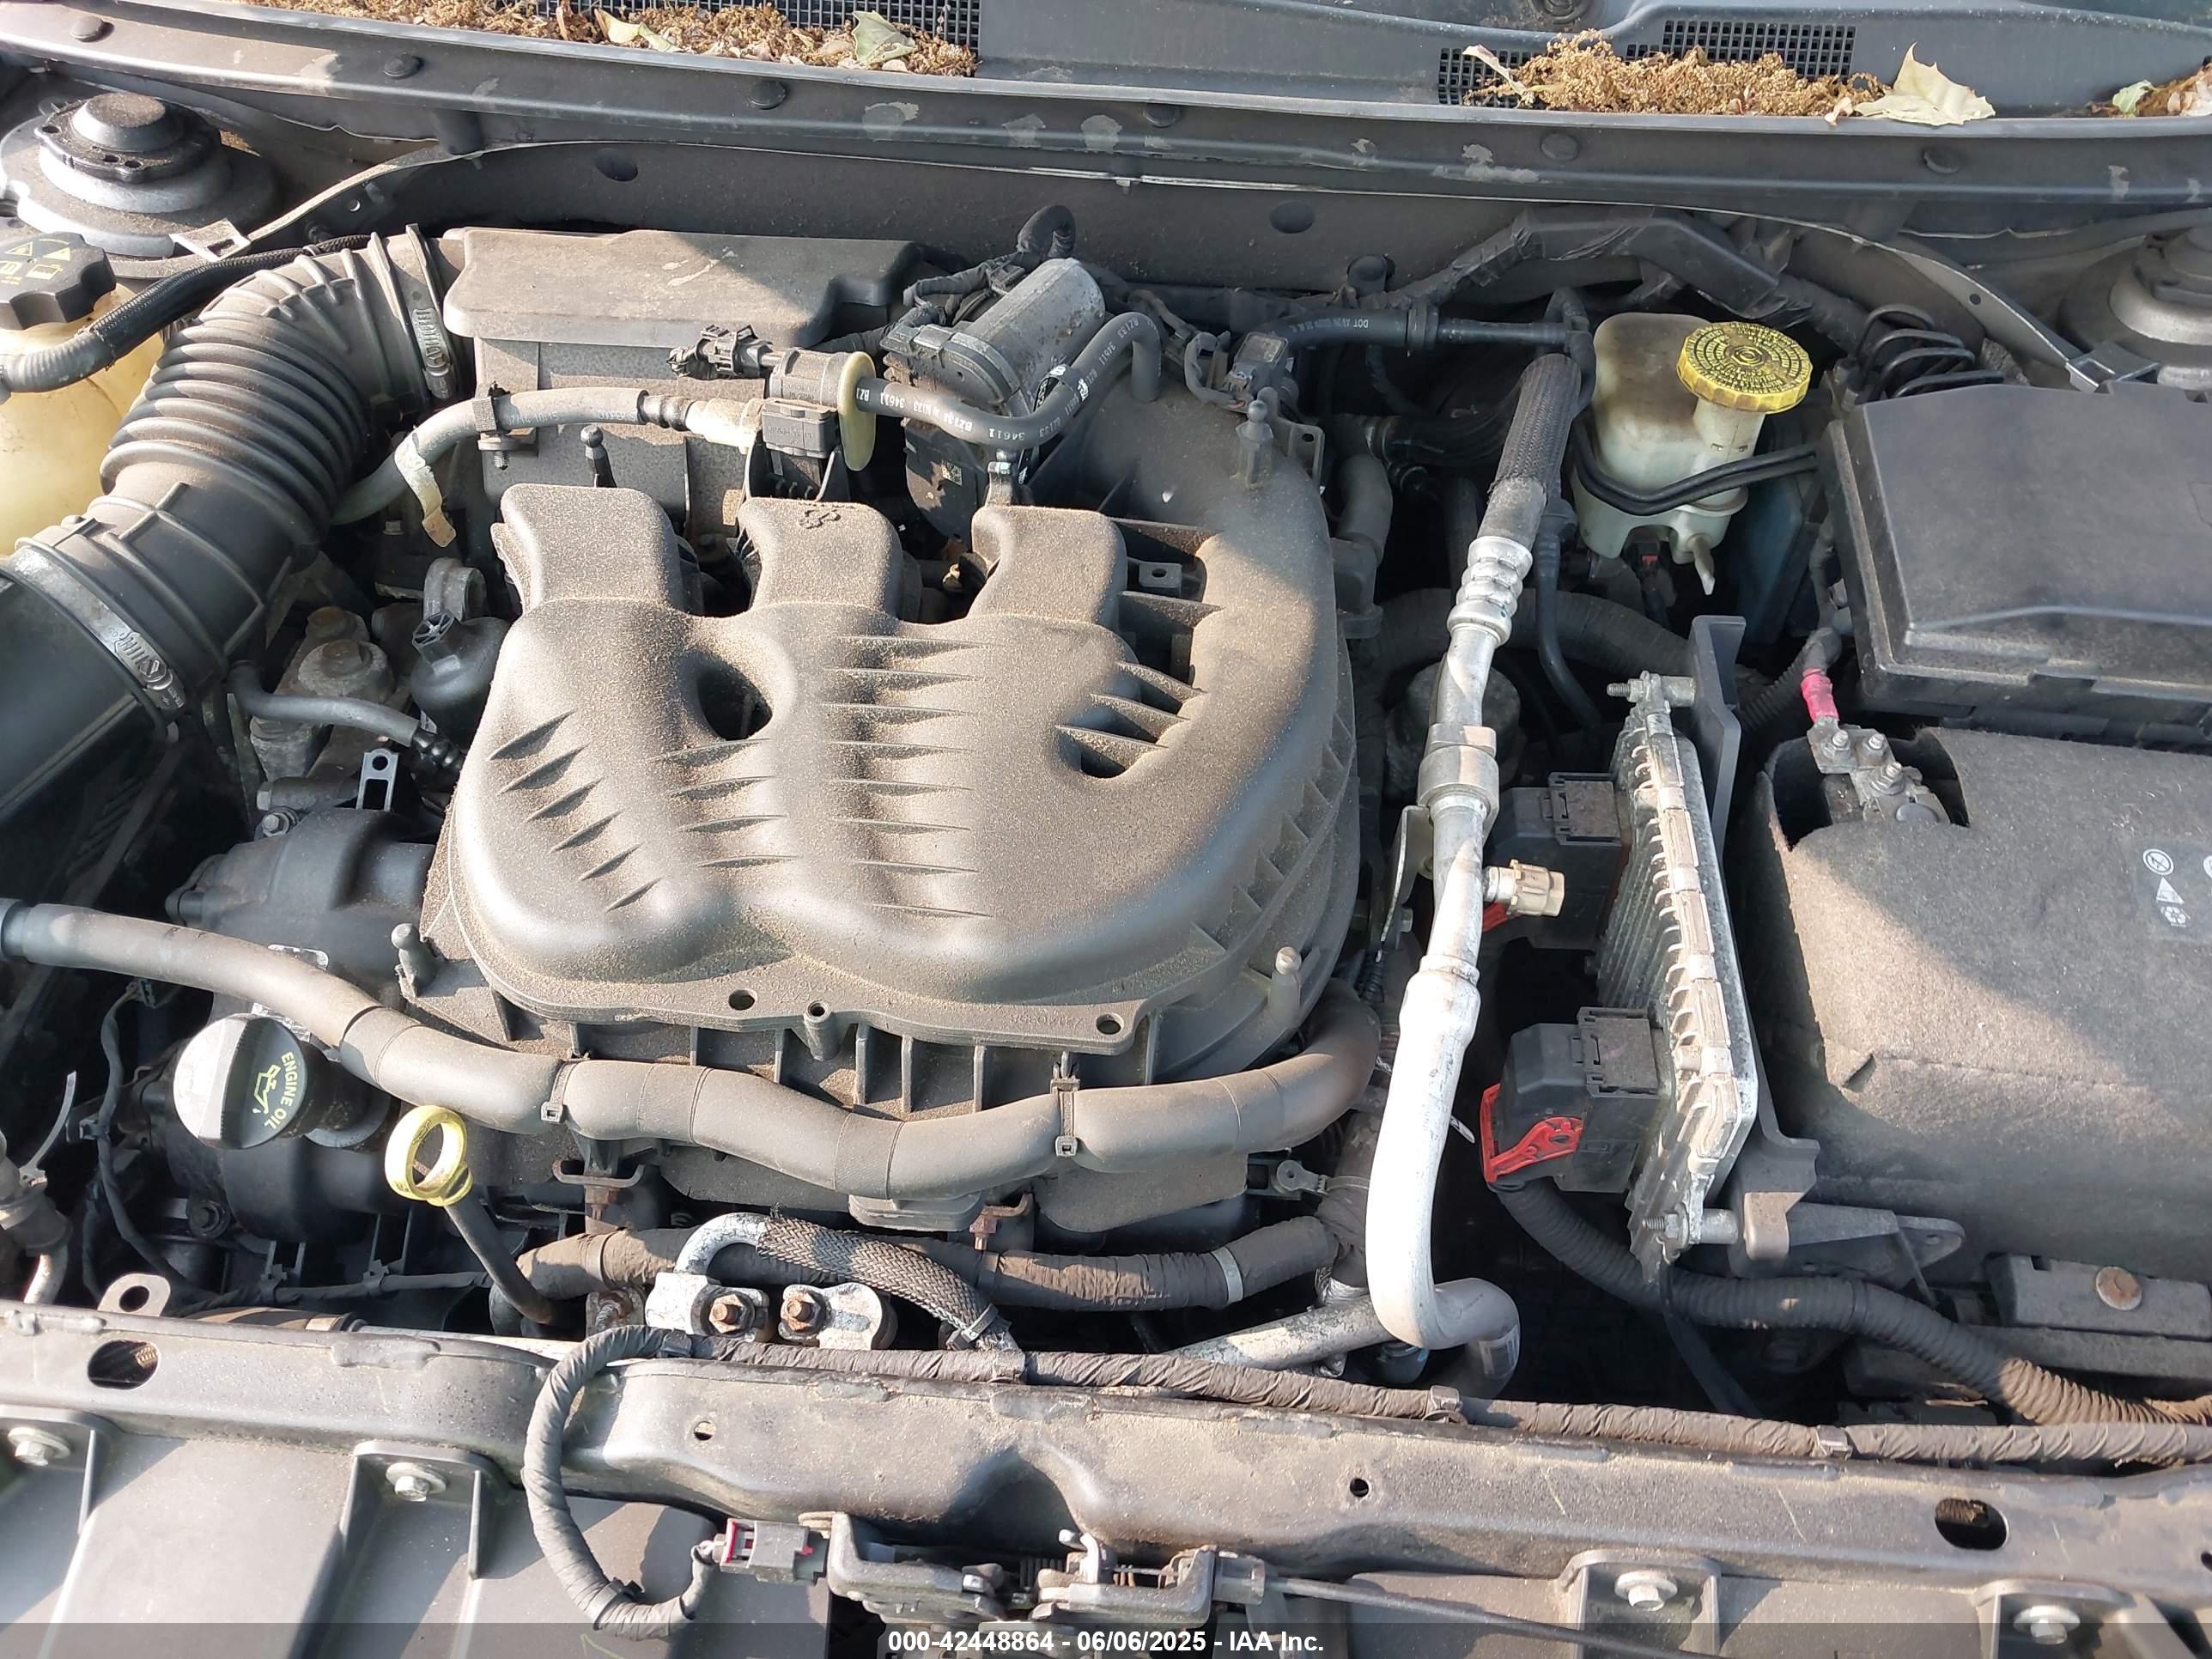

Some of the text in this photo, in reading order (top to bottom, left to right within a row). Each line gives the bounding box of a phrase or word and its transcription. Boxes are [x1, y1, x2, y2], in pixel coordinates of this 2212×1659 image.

[1352, 319, 1369, 329] DOT
[988, 426, 1026, 441] 34611
[264, 1052, 298, 1129] ENGINE OIL
